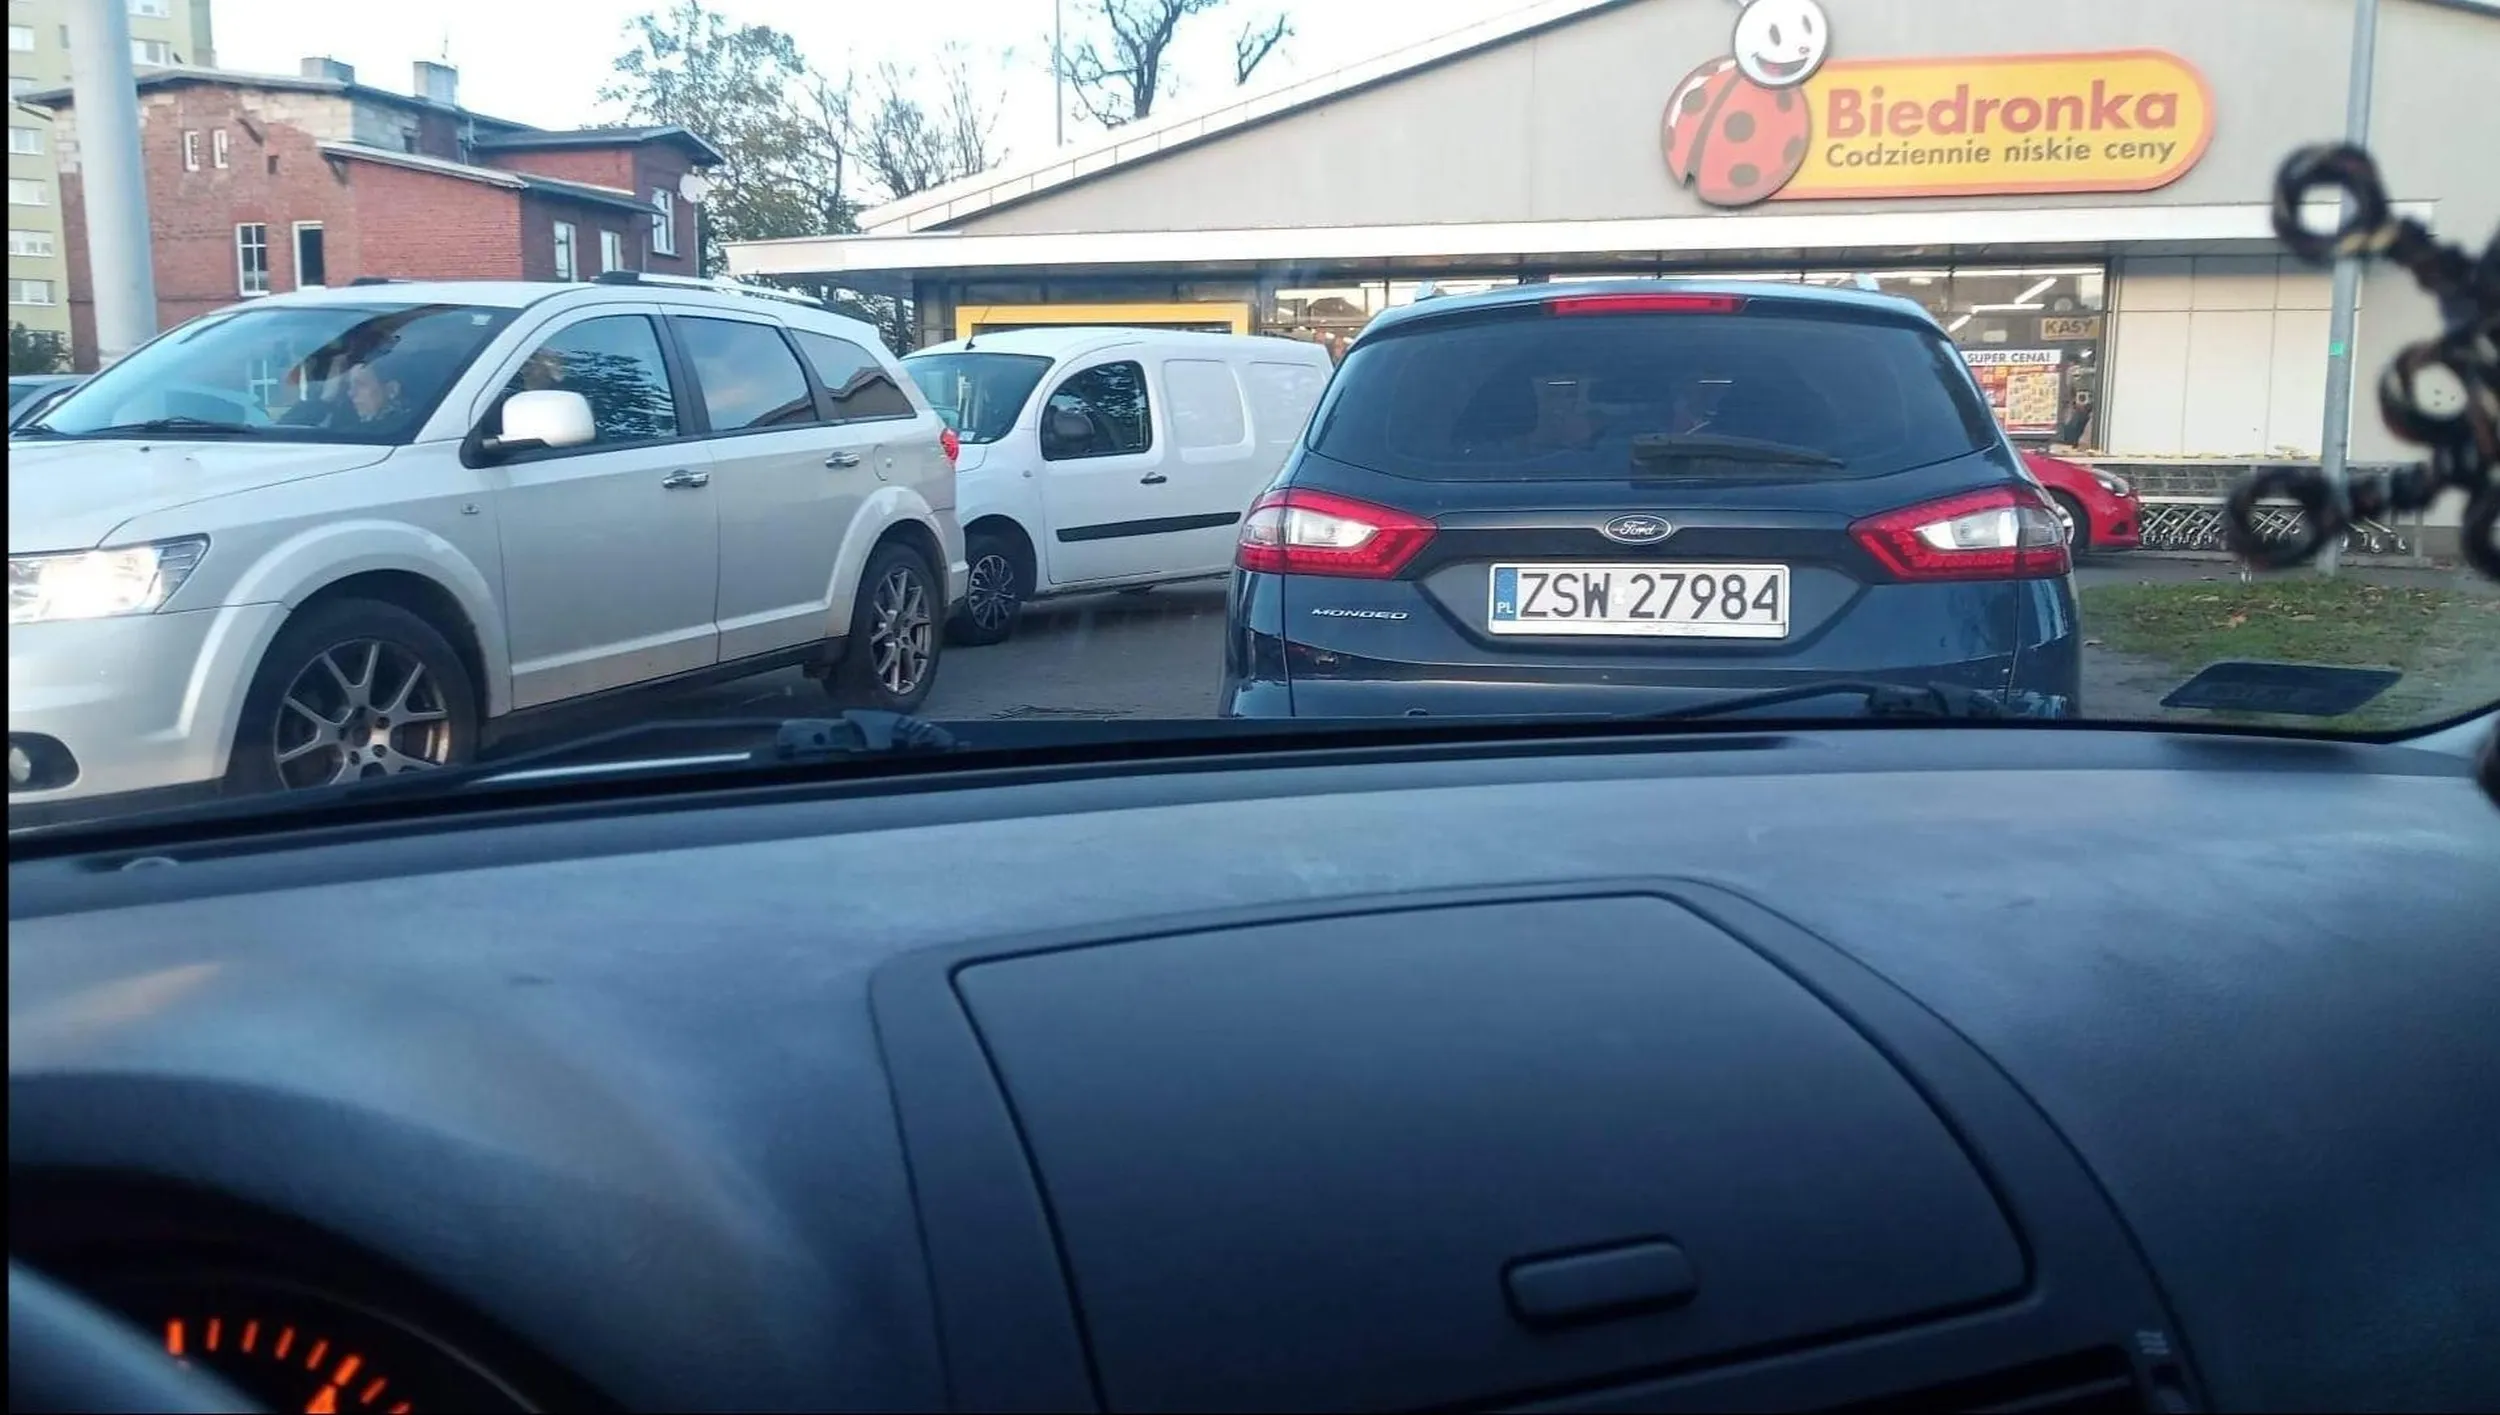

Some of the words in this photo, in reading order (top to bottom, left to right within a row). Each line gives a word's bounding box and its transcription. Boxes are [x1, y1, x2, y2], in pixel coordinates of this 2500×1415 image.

[1827, 80, 2178, 138] Biedronka
[1825, 140, 1991, 168] Codziennie
[2004, 138, 2091, 161] niskie
[2104, 141, 2176, 163] ceny
[2044, 319, 2094, 335] KASY
[1967, 353, 2007, 364] SUPER
[2010, 352, 2050, 363] CENA!
[1618, 520, 1656, 536] Ford
[1520, 572, 1611, 618] ZSW
[1629, 573, 1779, 621] 27984
[1311, 608, 1408, 619] MONDEO
[1496, 602, 1514, 614] PL
